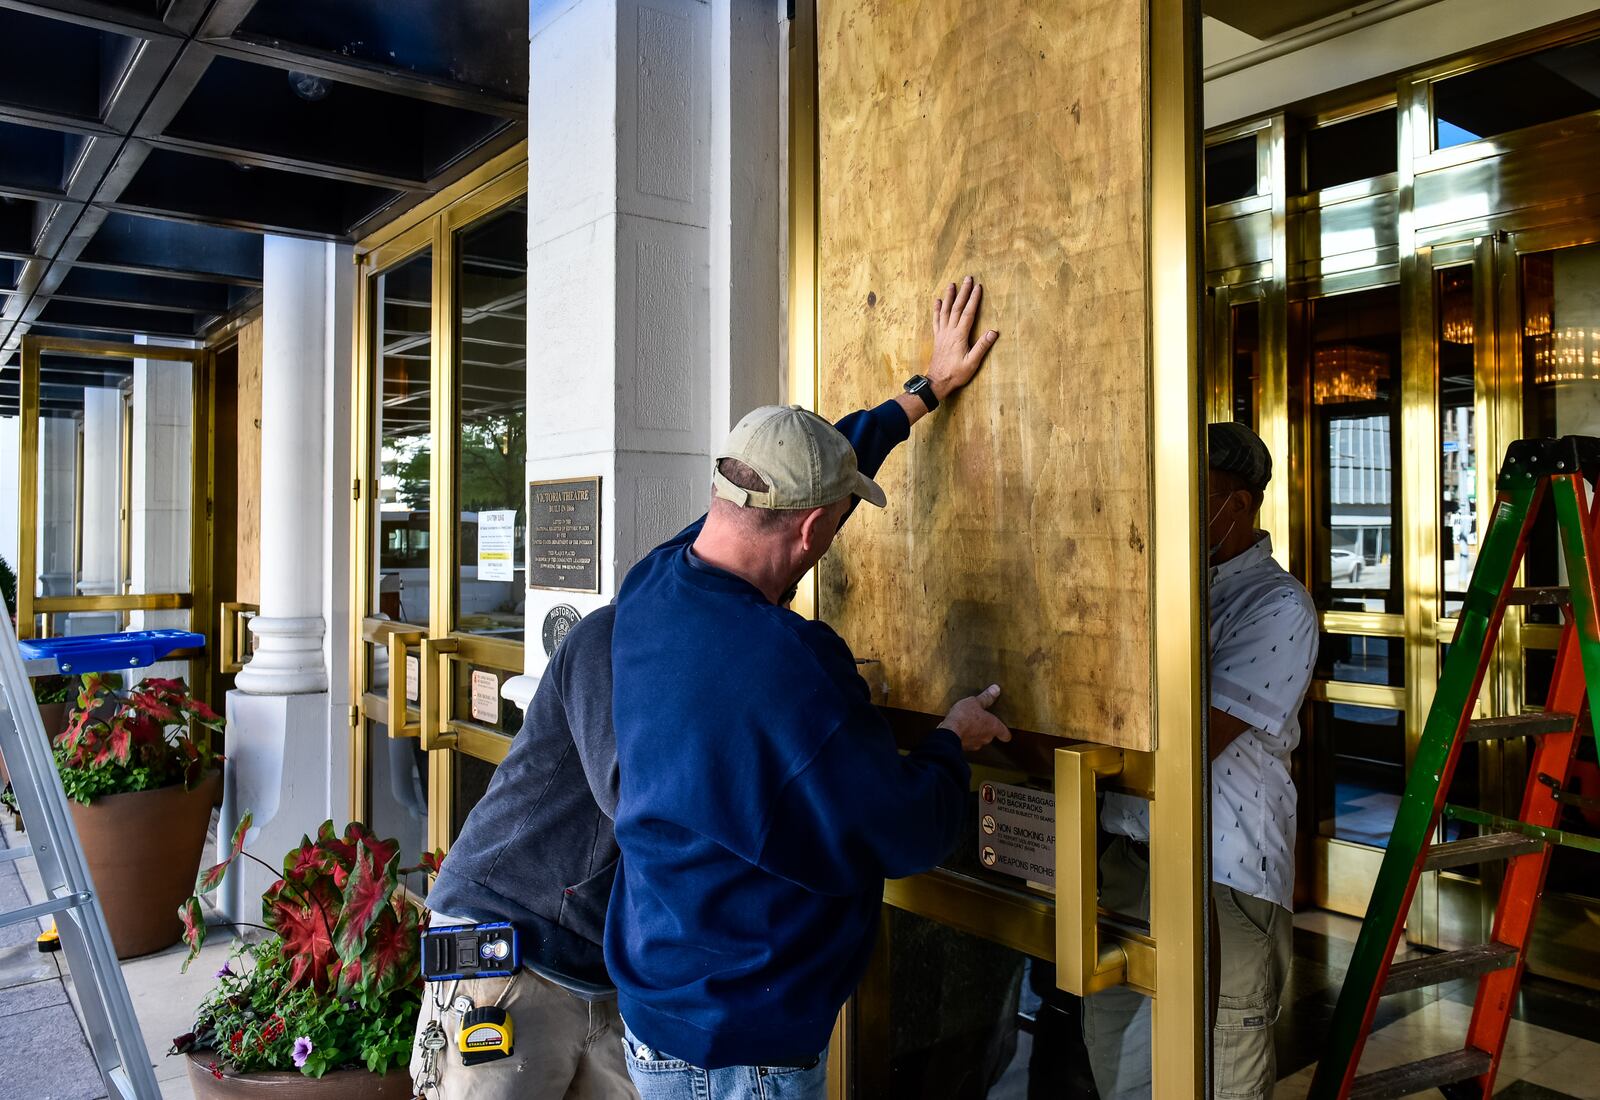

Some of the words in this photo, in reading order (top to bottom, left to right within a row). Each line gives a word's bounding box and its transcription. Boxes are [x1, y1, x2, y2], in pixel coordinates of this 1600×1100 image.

[536, 492, 562, 503] VICTORIA
[562, 489, 590, 501] THEATRE
[550, 607, 576, 622] HISTORIC
[997, 788, 1006, 797] NO
[1007, 790, 1027, 801] LARGE
[997, 797, 1006, 806] NO
[1007, 799, 1043, 813] BACKPACKS
[997, 823, 1012, 833] NON
[1013, 826, 1044, 842] SMOKING
[998, 855, 1028, 870] WEAPONS
